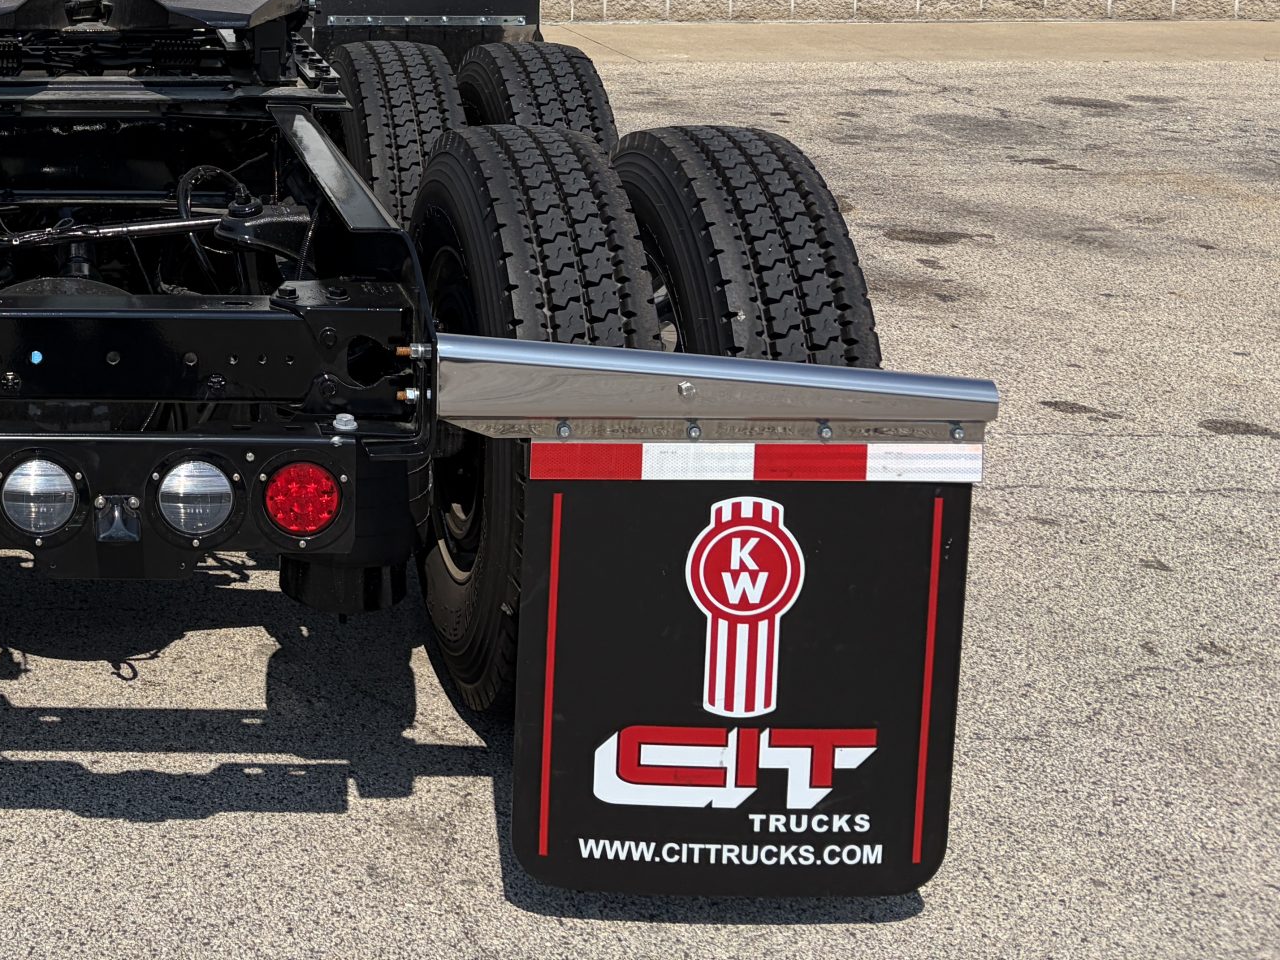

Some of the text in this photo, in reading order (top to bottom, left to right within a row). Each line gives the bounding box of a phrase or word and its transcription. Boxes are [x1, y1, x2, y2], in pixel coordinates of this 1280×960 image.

[730, 537, 760, 570] K
[720, 571, 769, 605] W
[593, 725, 878, 810] CIT
[748, 813, 871, 833] TRUCKS
[578, 838, 883, 866] WWW.CITTRUCKS.COM
